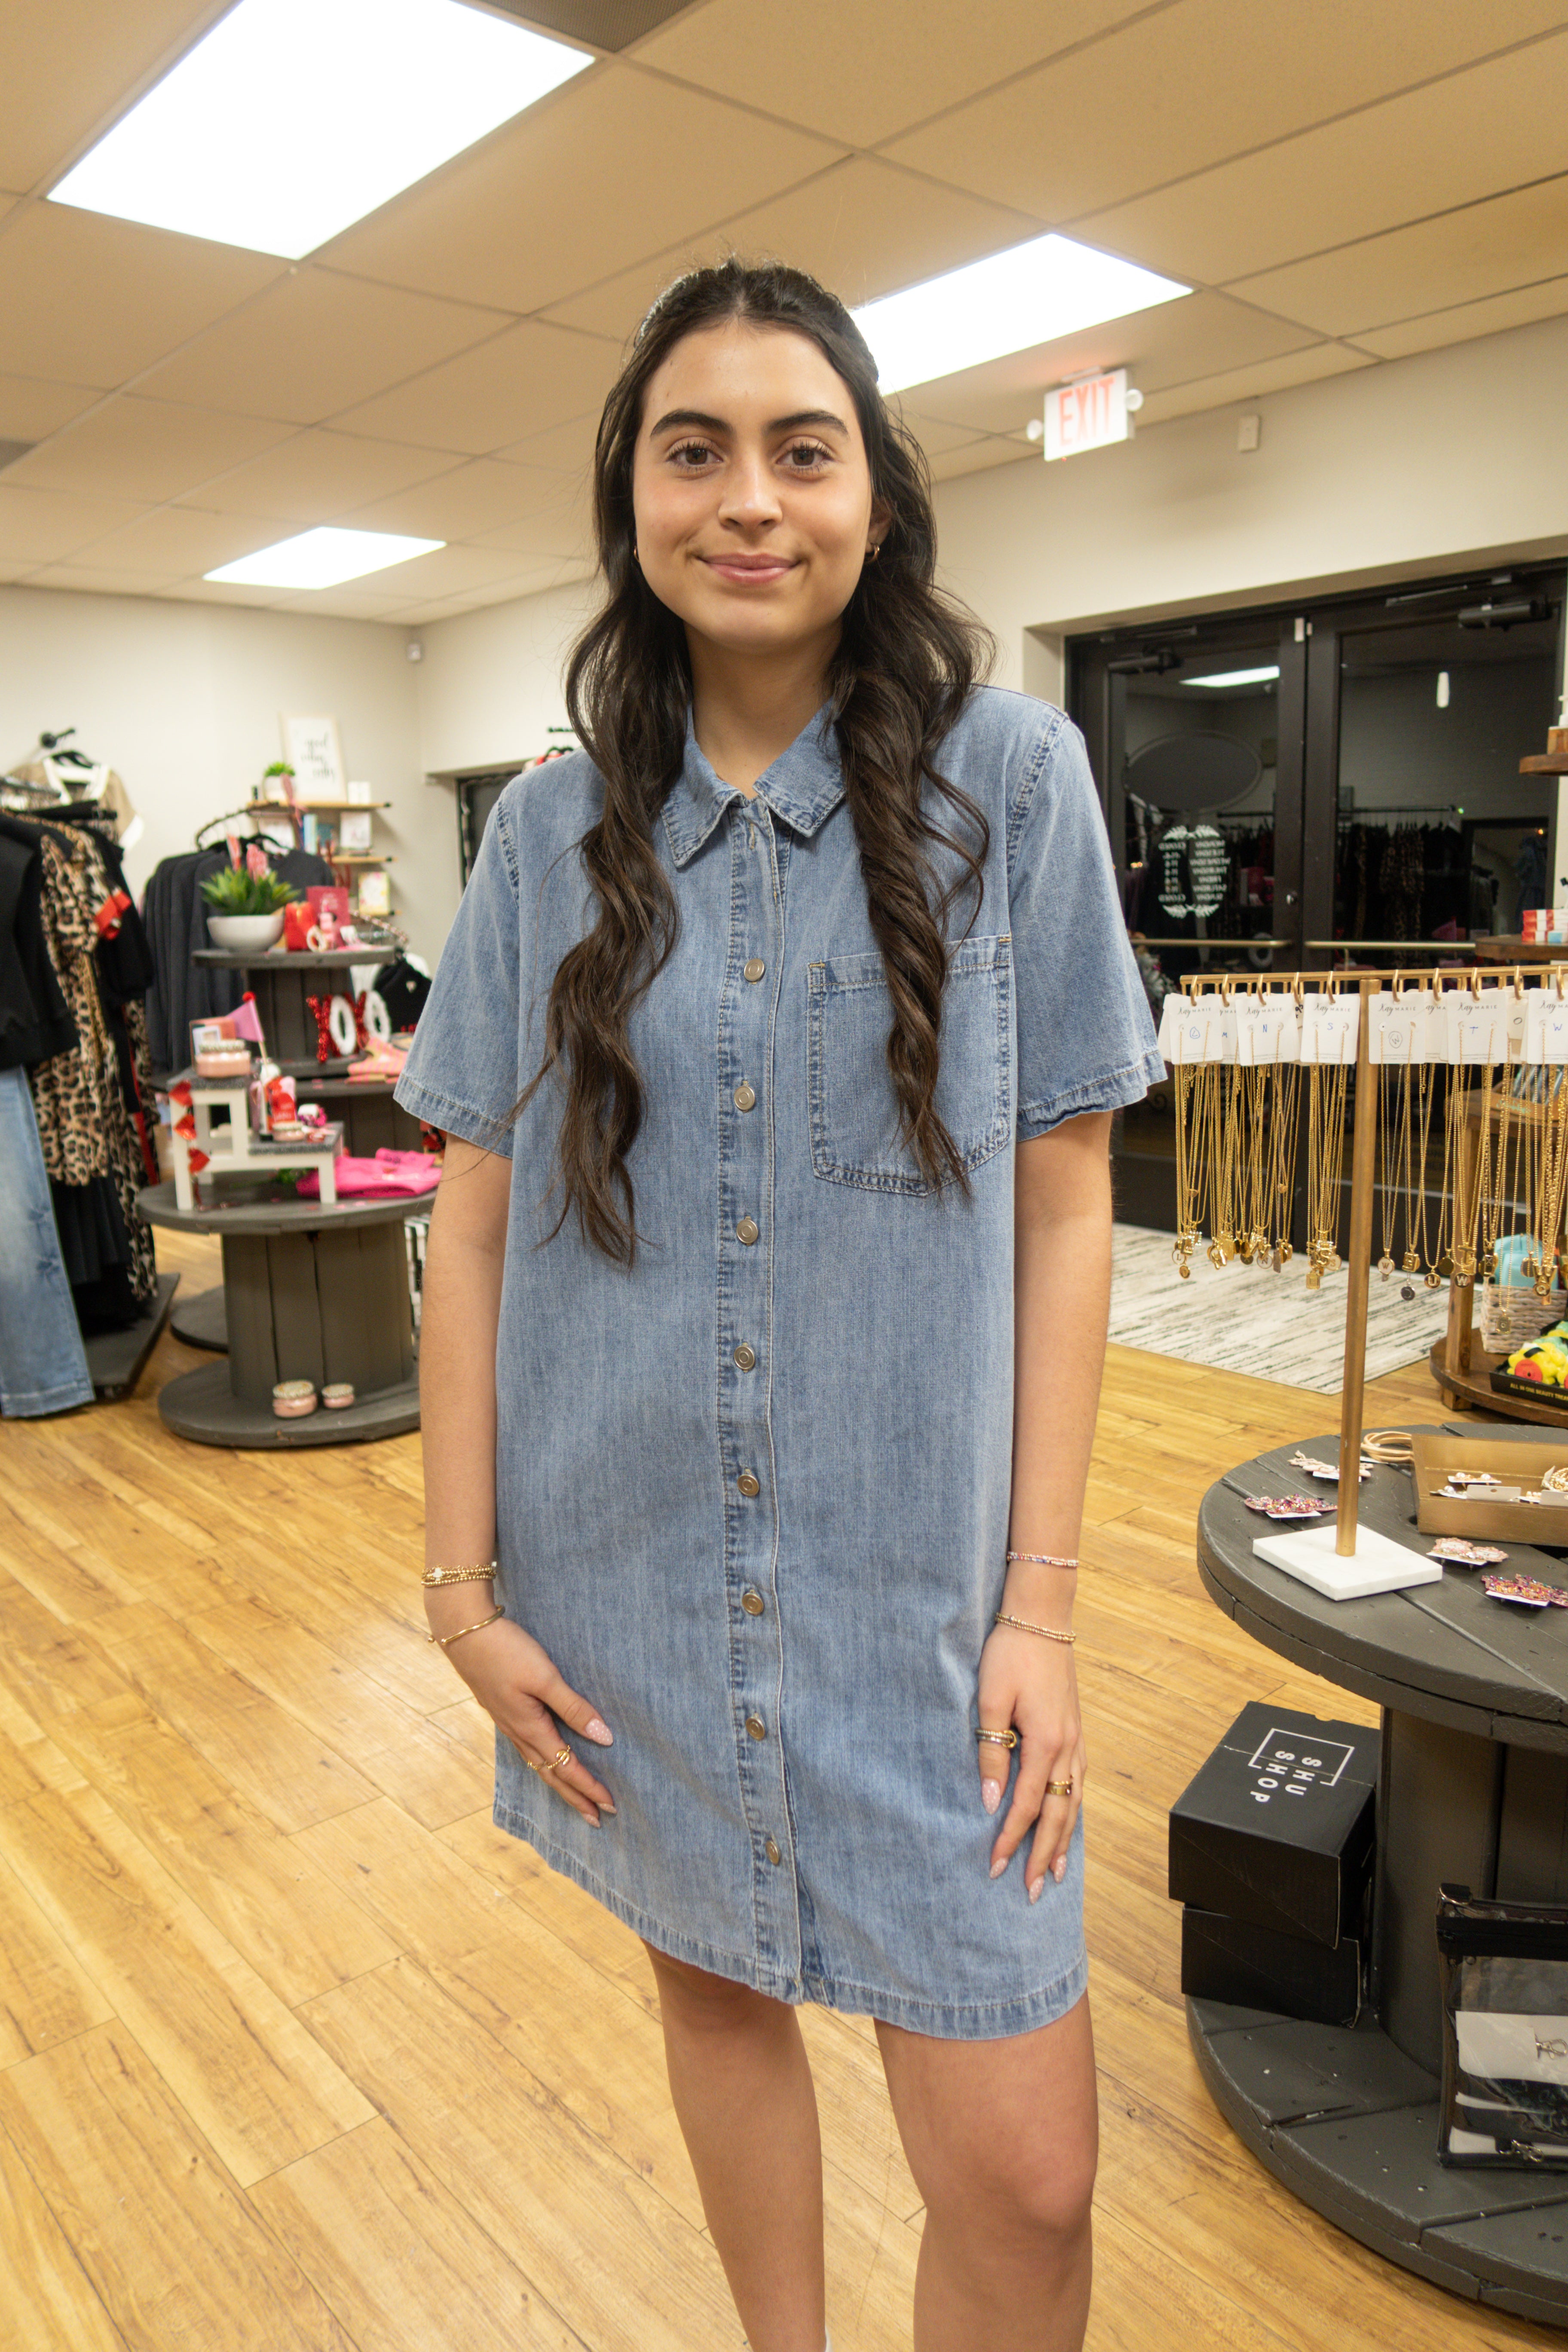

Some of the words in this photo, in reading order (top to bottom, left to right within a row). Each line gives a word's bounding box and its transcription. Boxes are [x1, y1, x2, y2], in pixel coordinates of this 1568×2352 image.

[1059, 376, 1115, 446] EXIT
[1262, 1024, 1268, 1033] N
[1553, 1023, 1562, 1031] W
[1250, 1750, 1295, 1803] SHOP
[1285, 1757, 1322, 1796] SHU
